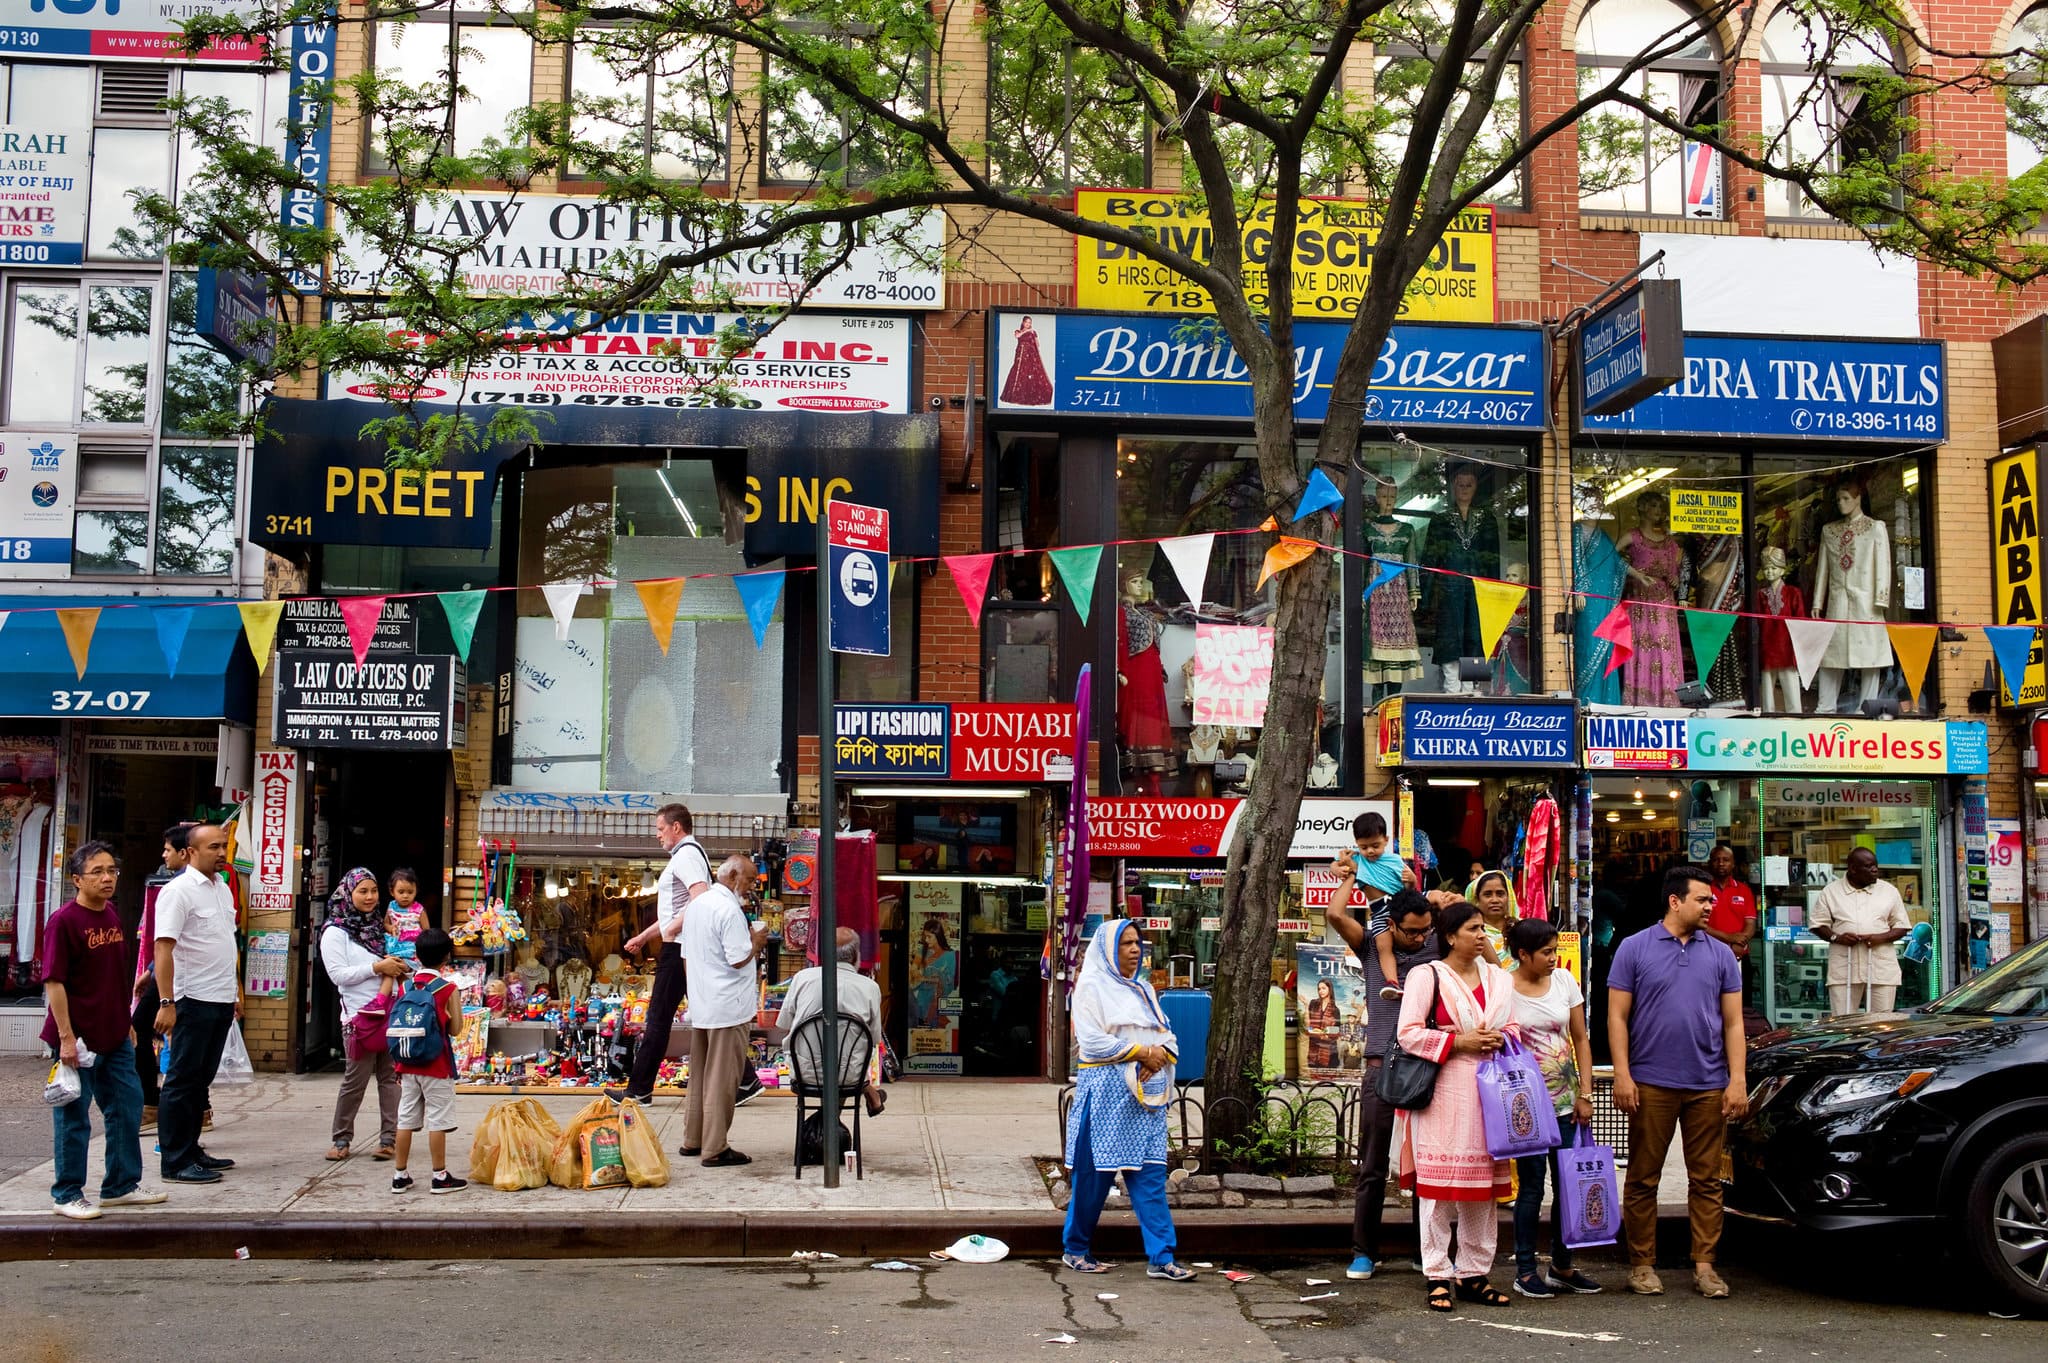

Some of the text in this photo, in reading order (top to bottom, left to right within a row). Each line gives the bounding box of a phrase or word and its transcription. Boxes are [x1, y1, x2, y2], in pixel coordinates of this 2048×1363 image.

[160, 5, 174, 17] NY
[0, 133, 68, 155] RAH
[21, 176, 37, 188] OF
[43, 177, 75, 191] HAJJ
[1106, 198, 1323, 224] BOAY
[408, 200, 781, 250] LAW OFFICS
[1096, 225, 1477, 273] DRIVIG SCHOL
[475, 244, 802, 276] MAHIPL INGH
[460, 273, 584, 292] MMIGRATION
[877, 270, 897, 283] 718
[1097, 265, 1477, 299] 5 EFEIVE COURSE
[727, 281, 813, 299] MATTERS
[843, 284, 936, 301] 478-4000
[476, 310, 715, 335] AXMEN
[842, 318, 894, 330] SUITE # 205
[1584, 307, 1640, 361] Bombay Bazar
[782, 340, 889, 363] INC.
[499, 356, 527, 370] OF
[533, 357, 576, 371] TAX
[584, 358, 600, 371] &
[609, 359, 749, 377] ACCOUNTING
[755, 363, 851, 379] SERVICES
[1089, 325, 1526, 404] Bomby Bazar
[1585, 344, 1641, 399] KHERA TRAVELS
[492, 371, 522, 381] FOR
[1655, 356, 1940, 406] ERA TRAVELS
[407, 387, 438, 398] TURNS
[533, 383, 567, 393] AND
[470, 390, 562, 406] (718)
[788, 397, 833, 408] BOOKKEEPING
[839, 399, 851, 409] TAX
[852, 400, 882, 410] SERVICES
[1070, 389, 1534, 422] 37-11 718-424-8067
[1815, 412, 1937, 433] 718-396-1148
[32, 457, 60, 466] IATA
[325, 466, 485, 518] PREET
[1676, 493, 1737, 508] JASSAL TAILORS
[851, 508, 866, 522] NO
[265, 514, 312, 536] 37-11
[837, 519, 882, 538] STANDING
[1, 540, 32, 560] 18
[286, 601, 330, 617] TAXMEN &
[296, 622, 316, 633] TAX &
[306, 635, 352, 648] 718-478-62
[293, 662, 435, 691] LAW OFFICES OF
[51, 690, 151, 712] 37-07
[301, 691, 426, 708] MAHIPAL SINGH, P.C.
[2003, 684, 2045, 703] 6-2300
[1194, 696, 1269, 724] SALE
[287, 714, 440, 727] IMMIGRATION & ALL LEGAL MATTERS
[836, 711, 942, 736] LIPI FASHION
[952, 712, 1073, 743] PUNJABI
[1414, 707, 1567, 736] Bombay Bazar
[285, 728, 438, 741] 37-11 2FL. TEL. 478-4000
[1589, 718, 1686, 750] NAMASTE
[88, 739, 219, 752] PRIME TIME TRAVEL & TOUR
[835, 736, 944, 767] লিপি ফ্যাশন
[1413, 738, 1567, 758] KHERA TRAVELS
[1614, 750, 1635, 760] CITY
[1636, 750, 1668, 760] XPRESS
[259, 752, 296, 770] TAX
[965, 747, 1061, 773] MUSIC
[1088, 802, 1226, 820] BOLLYWOOD
[261, 776, 289, 885] ACCOUNTANTS
[1088, 821, 1162, 839] MUSIC
[1295, 816, 1353, 836] oneyGr
[1089, 842, 1141, 851] 18.429.8800
[262, 885, 280, 893] (718)
[1307, 889, 1366, 905] PHO
[251, 894, 291, 908] 478-6200
[1149, 919, 1169, 928] BTV
[1298, 921, 1309, 931] TV
[908, 1061, 959, 1071] Lycamobile
